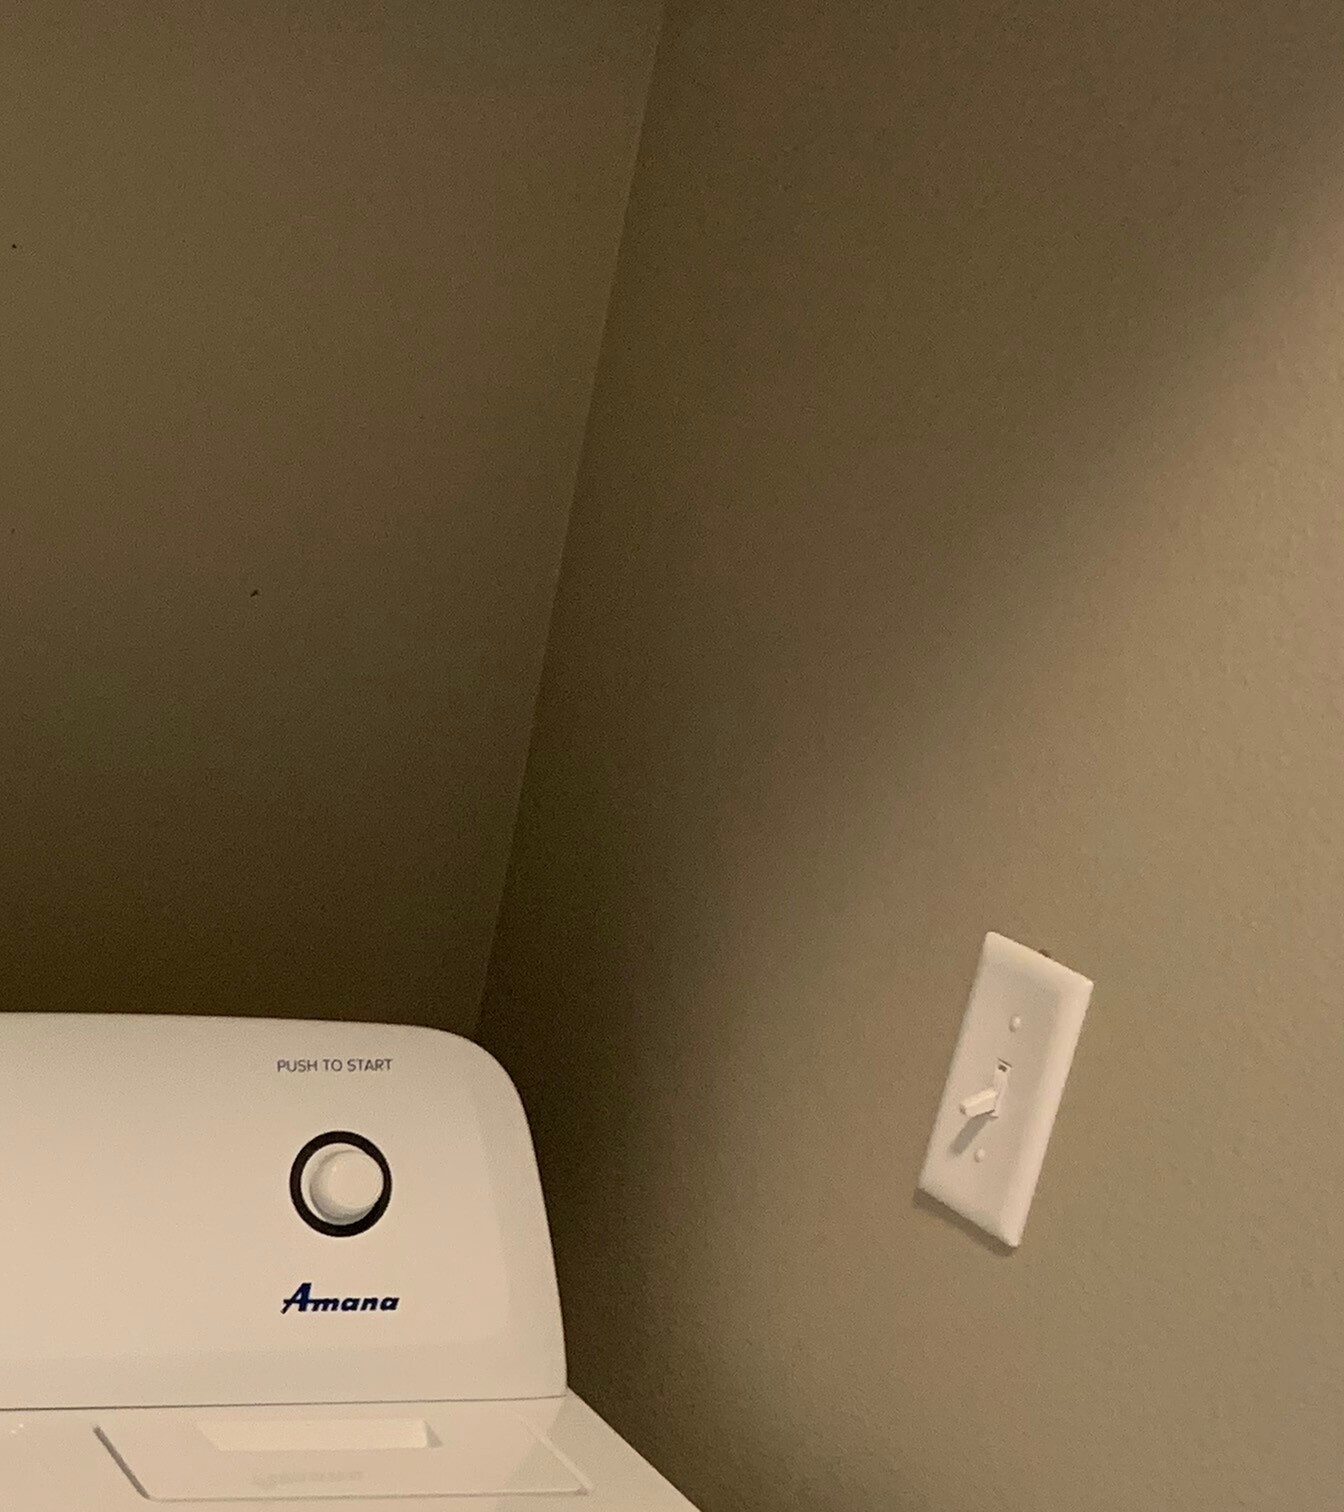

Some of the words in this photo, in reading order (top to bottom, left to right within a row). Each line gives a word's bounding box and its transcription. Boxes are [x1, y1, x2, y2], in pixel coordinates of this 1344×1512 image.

[277, 1059, 318, 1073] PUSH
[322, 1059, 343, 1072] TO
[347, 1058, 394, 1071] START
[280, 1283, 400, 1314] Amana
